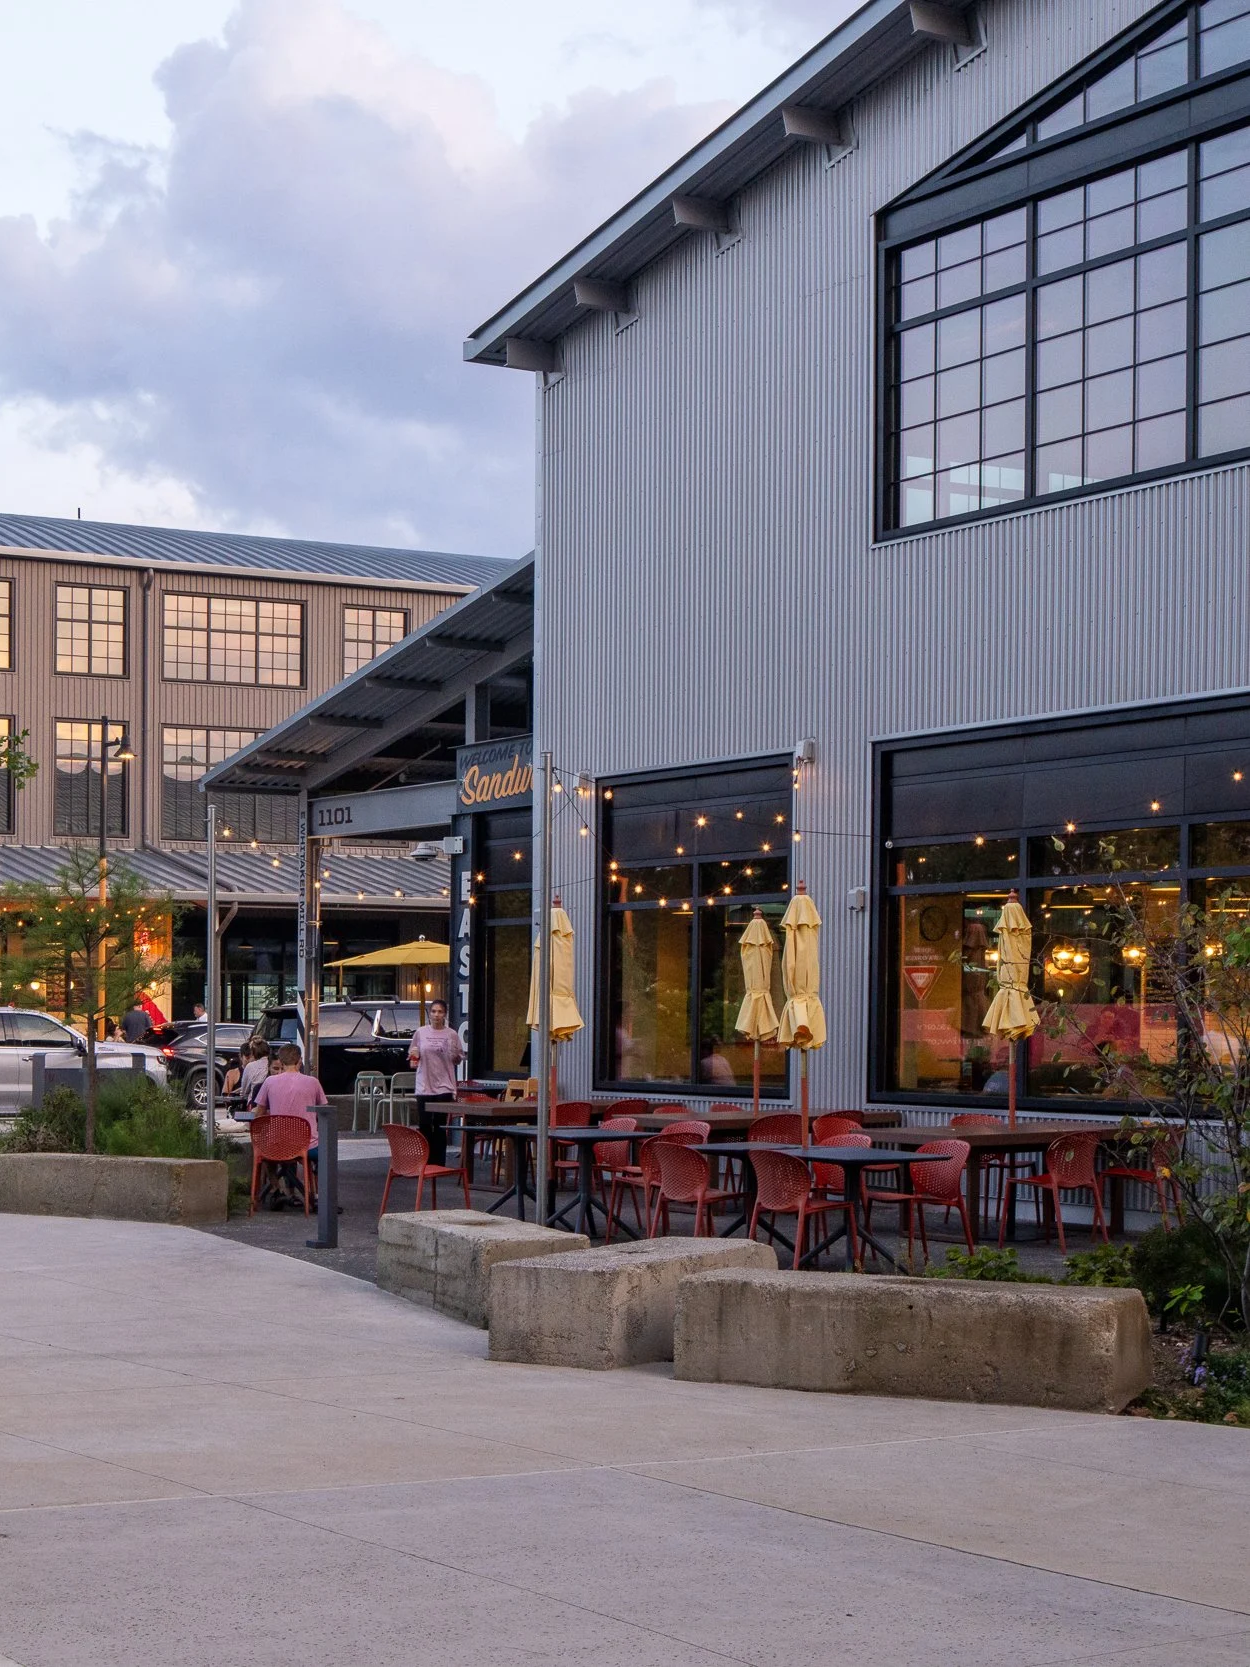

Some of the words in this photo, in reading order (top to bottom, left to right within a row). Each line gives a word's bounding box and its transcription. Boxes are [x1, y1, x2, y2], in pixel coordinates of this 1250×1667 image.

[460, 744, 516, 770] WELCOME
[519, 740, 533, 758] TO
[461, 754, 534, 805] Sandw
[300, 811, 306, 819] E
[318, 806, 353, 826] 1101
[299, 939, 305, 958] RD
